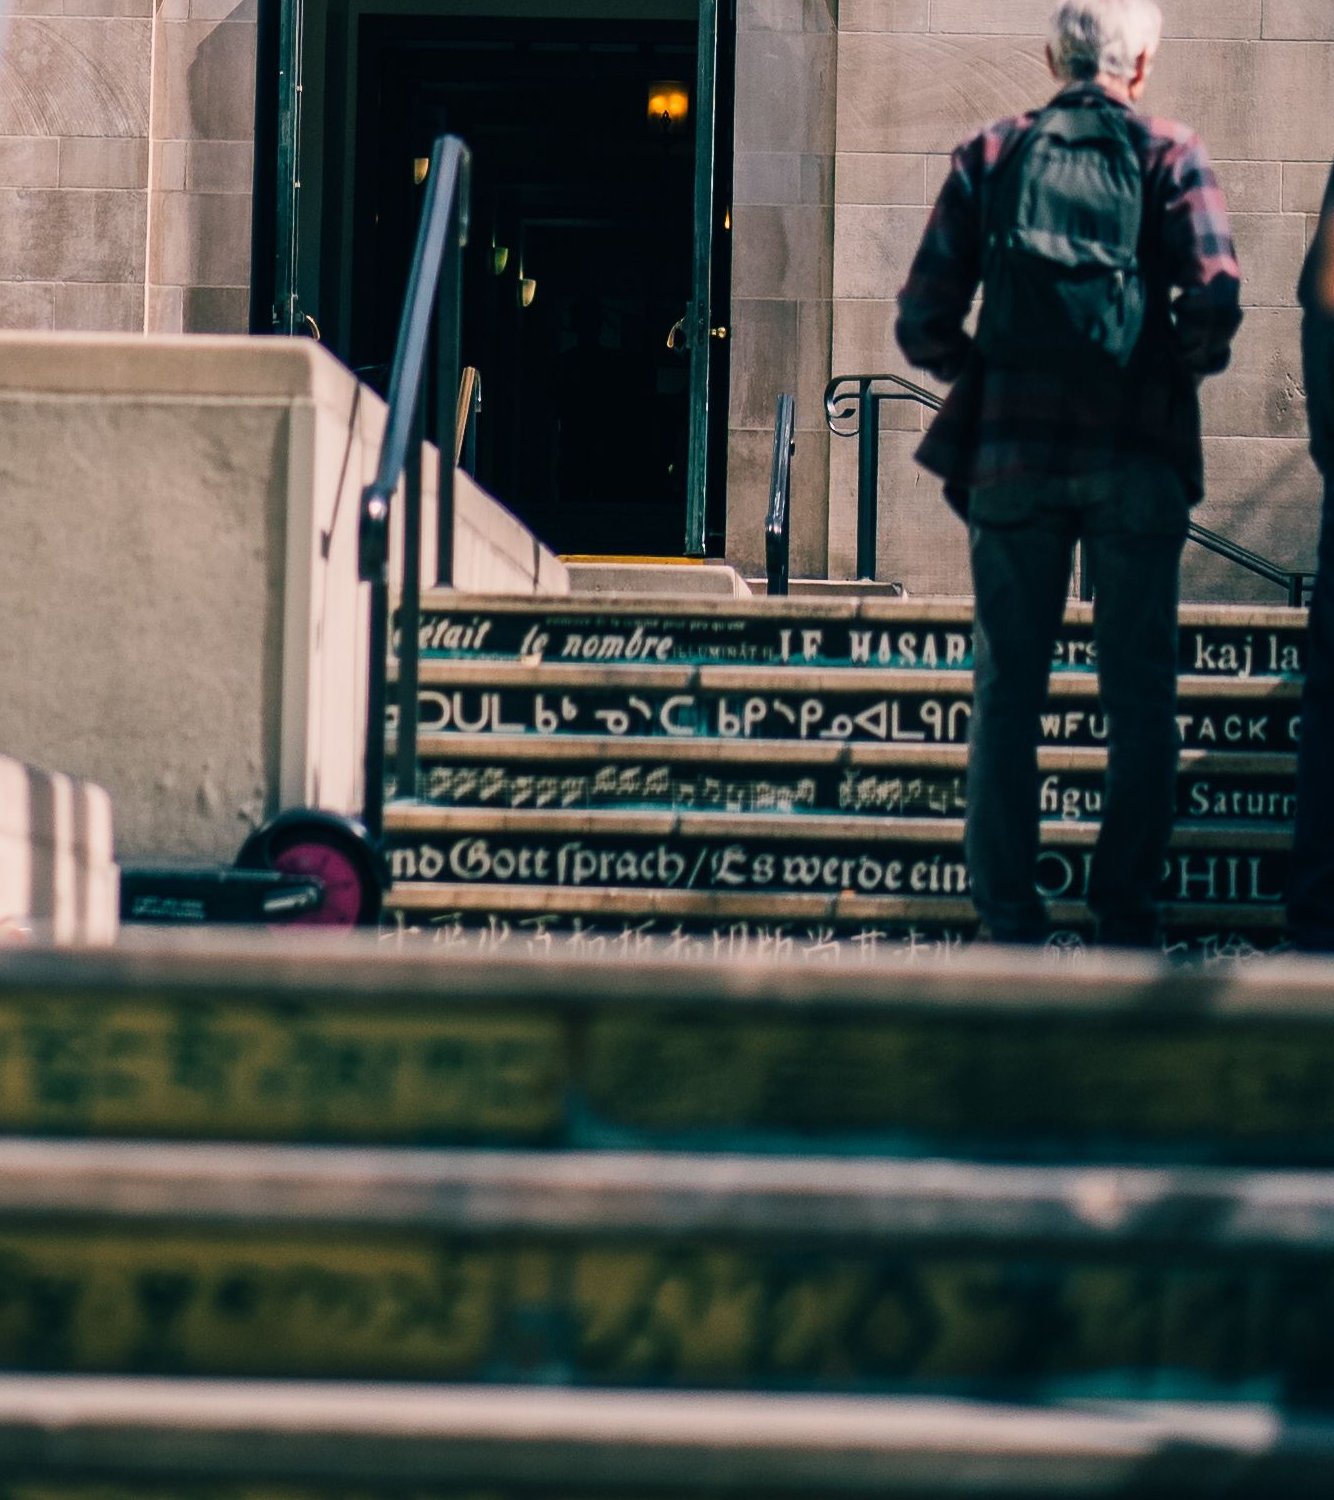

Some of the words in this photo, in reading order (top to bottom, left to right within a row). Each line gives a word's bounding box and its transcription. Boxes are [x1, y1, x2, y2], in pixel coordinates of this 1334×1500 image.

[562, 624, 675, 660] nombre
[848, 630, 973, 668] HASAR
[1194, 633, 1253, 678] kaj
[1269, 634, 1301, 670] la
[386, 843, 444, 879] nd
